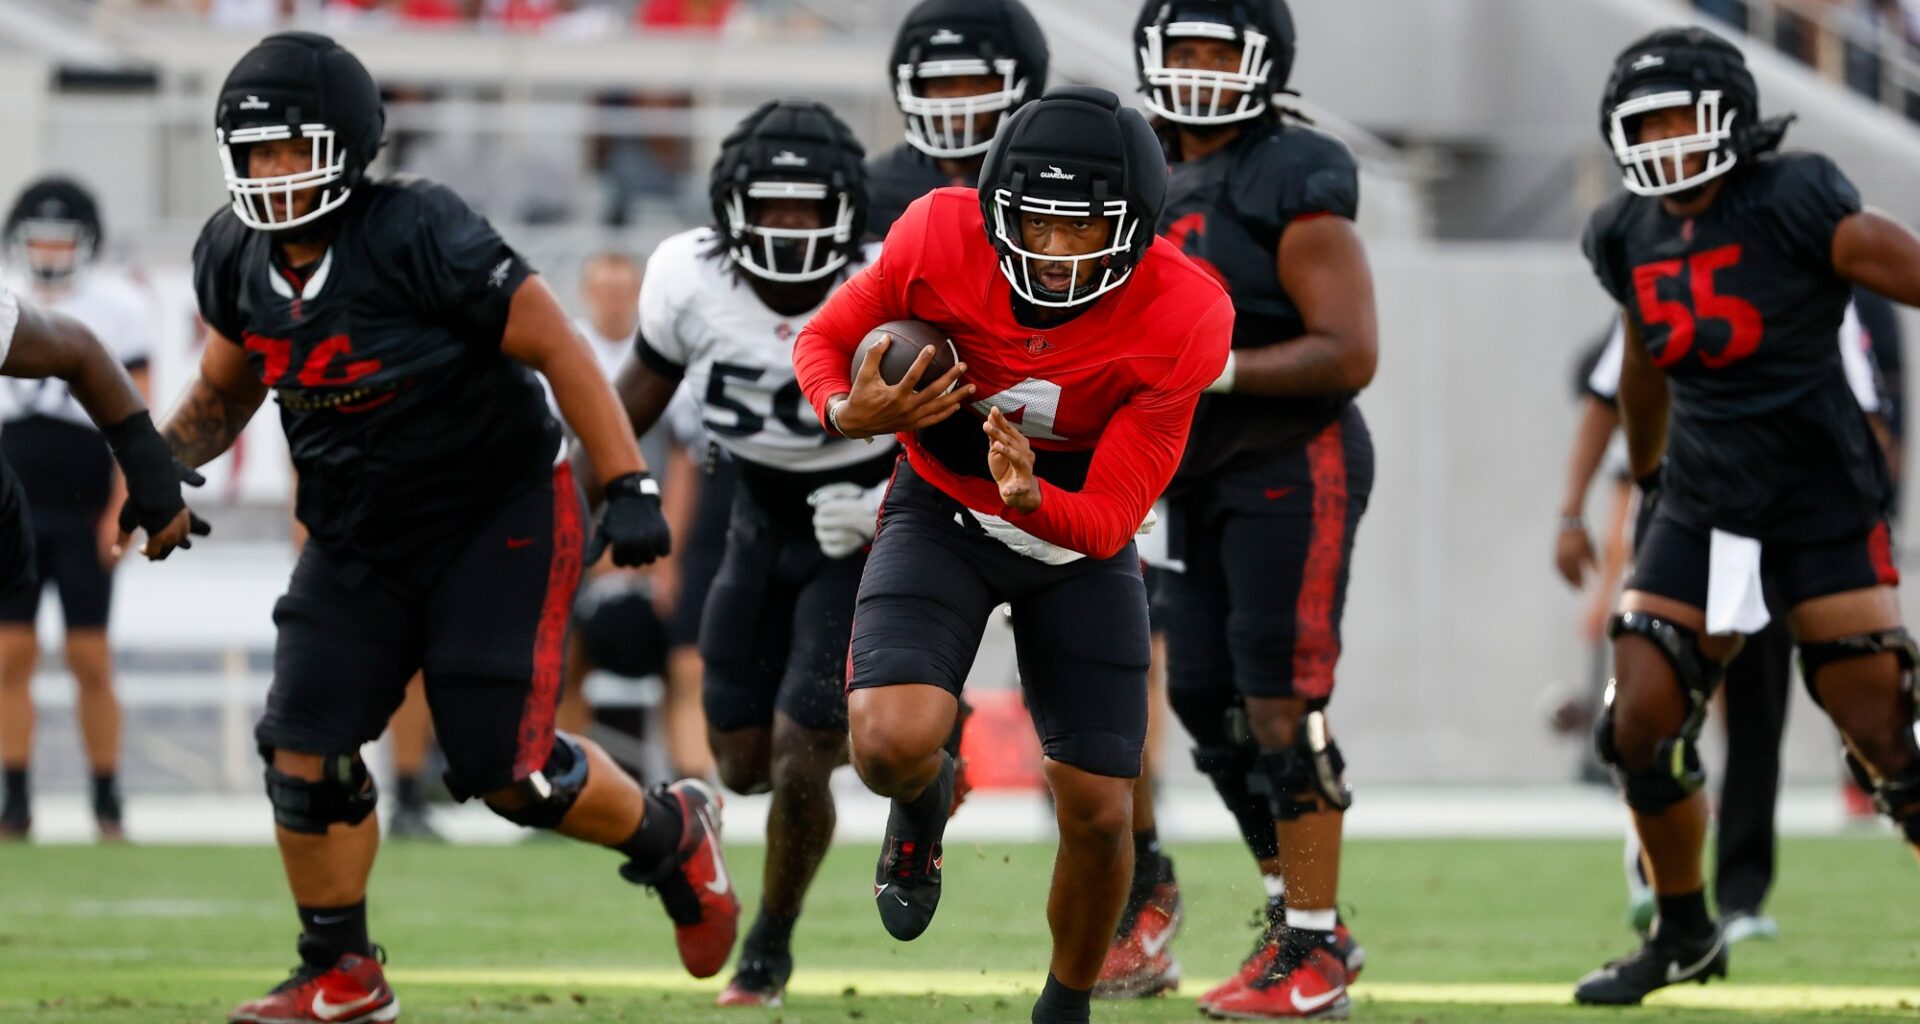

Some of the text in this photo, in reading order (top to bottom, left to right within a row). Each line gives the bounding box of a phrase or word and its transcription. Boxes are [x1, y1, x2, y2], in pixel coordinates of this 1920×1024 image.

[1040, 171, 1074, 180] GUARDIAN
[1632, 243, 1764, 368] 55
[971, 377, 1069, 441] 4
